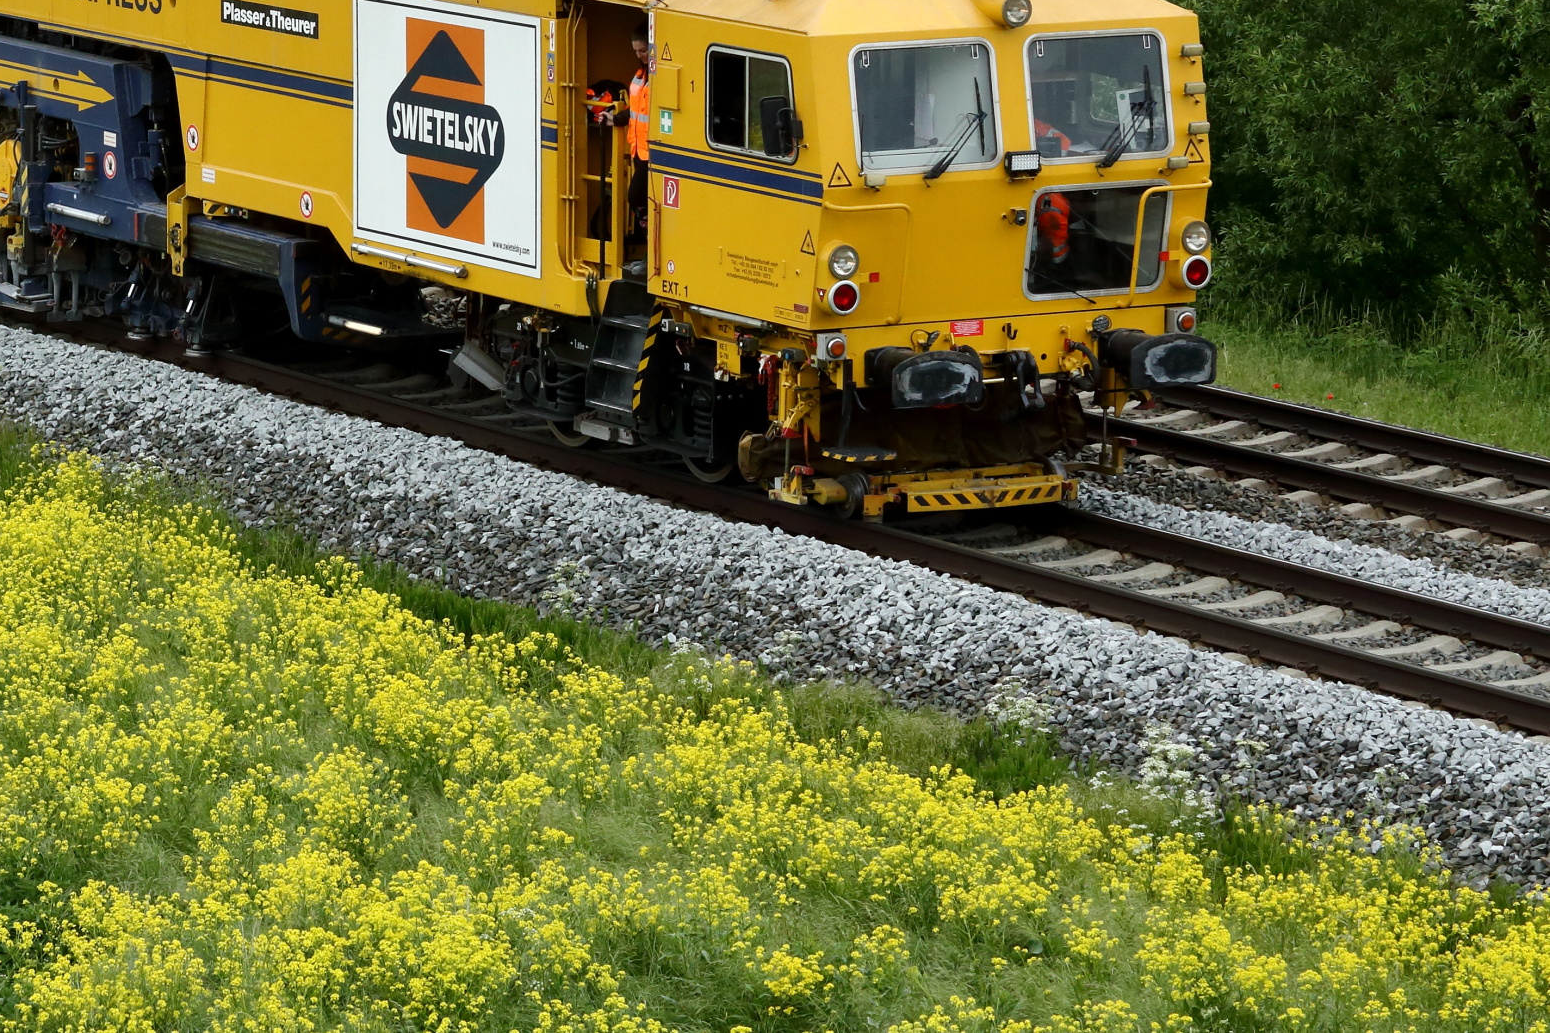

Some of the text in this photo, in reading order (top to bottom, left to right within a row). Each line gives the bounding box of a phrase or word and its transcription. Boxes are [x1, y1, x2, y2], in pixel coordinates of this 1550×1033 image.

[690, 79, 695, 93] 1
[392, 100, 499, 157] SWIETELSKY
[662, 279, 689, 298] EXT. 1
